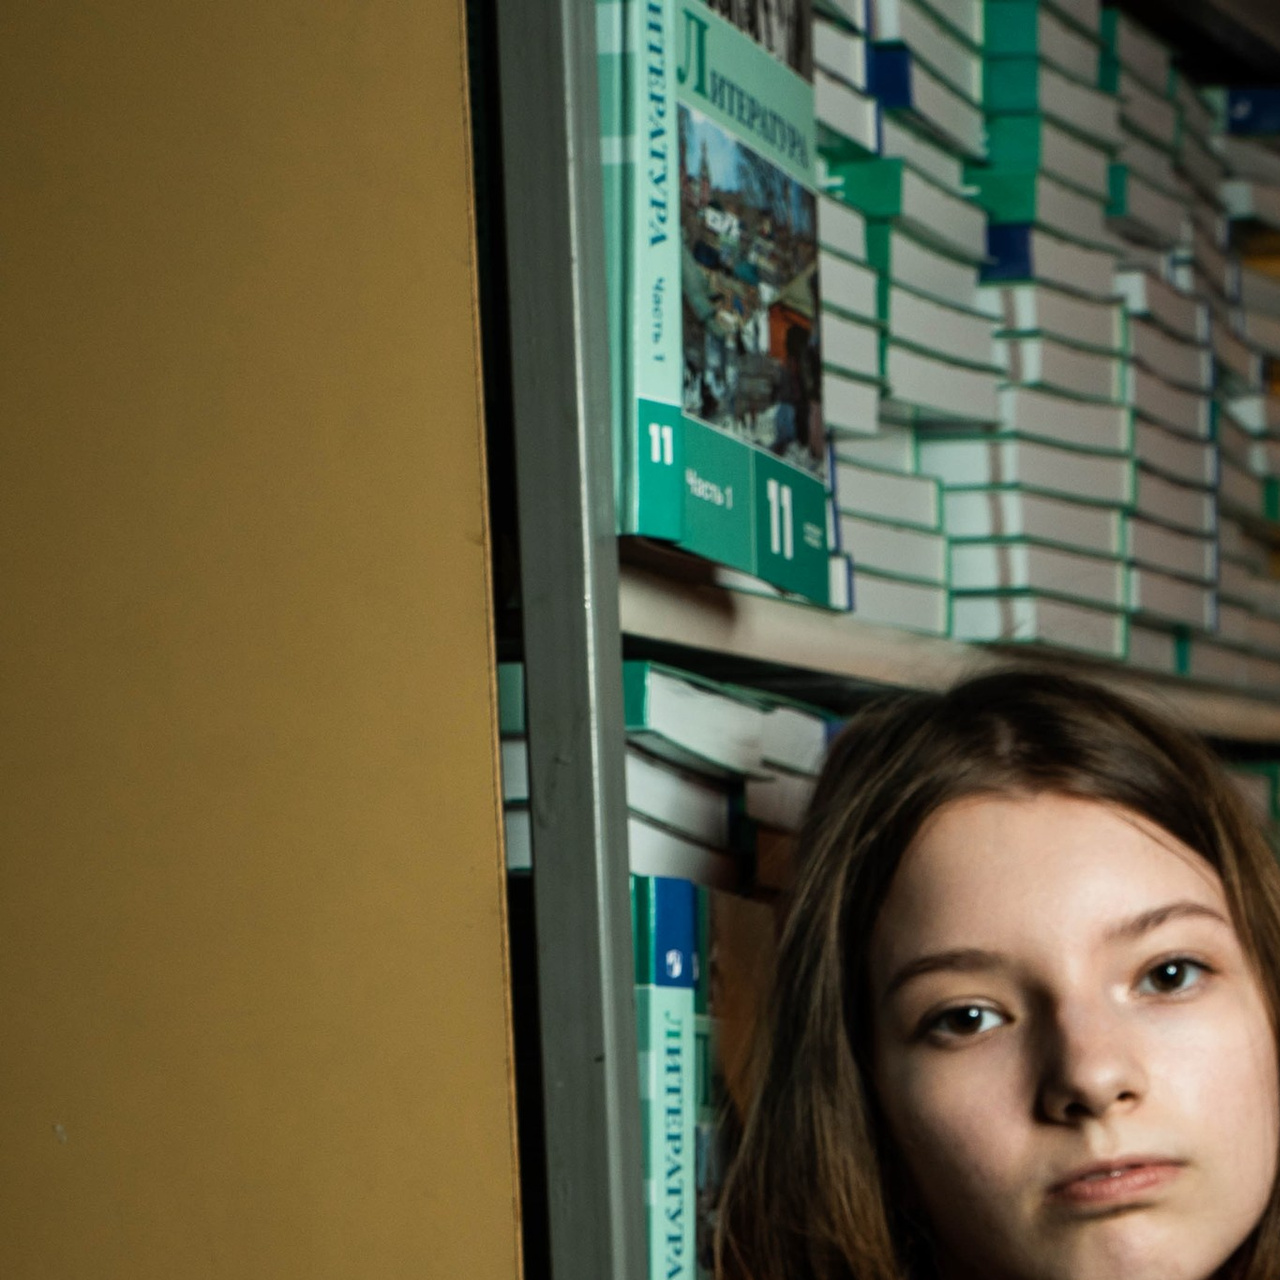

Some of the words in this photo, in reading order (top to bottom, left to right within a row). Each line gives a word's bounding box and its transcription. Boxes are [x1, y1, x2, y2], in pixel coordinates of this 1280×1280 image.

[647, 0, 667, 246] ИТЕРАТУРА
[651, 276, 666, 344] Часть
[648, 422, 674, 466] 11
[685, 466, 725, 507] Часть
[724, 485, 734, 511] 1
[766, 477, 794, 561] 11
[665, 1010, 683, 1280] ЛИТЕРАТУРА
